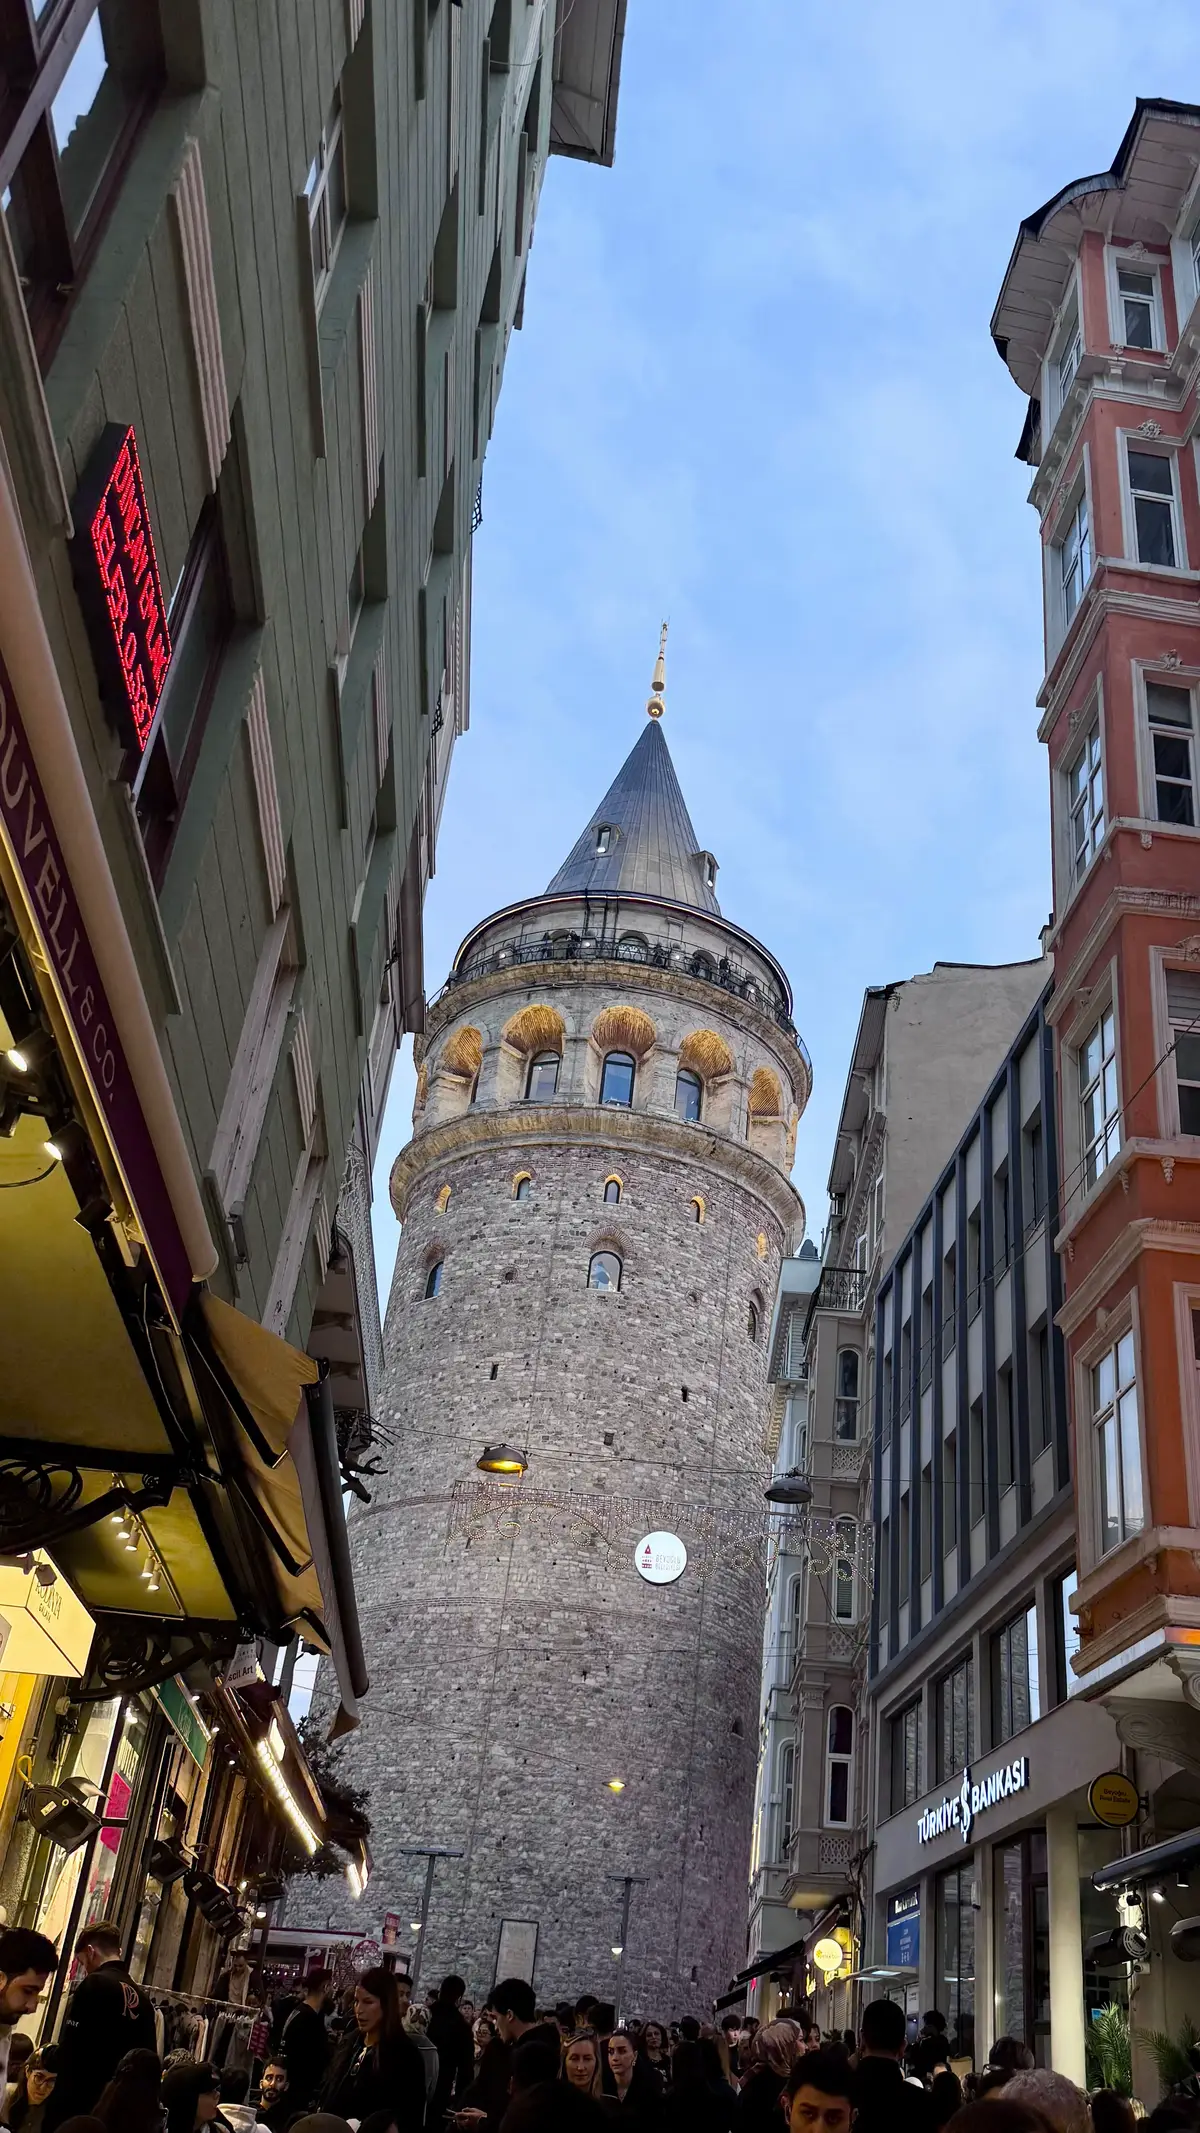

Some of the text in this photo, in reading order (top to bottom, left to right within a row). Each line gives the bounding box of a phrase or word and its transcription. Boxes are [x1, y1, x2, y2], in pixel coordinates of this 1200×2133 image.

[139, 571, 167, 692] EMLAK
[79, 984, 95, 1027] &
[917, 1796, 960, 1844] TÜRKİYE
[971, 1756, 1025, 1815] BANKASI
